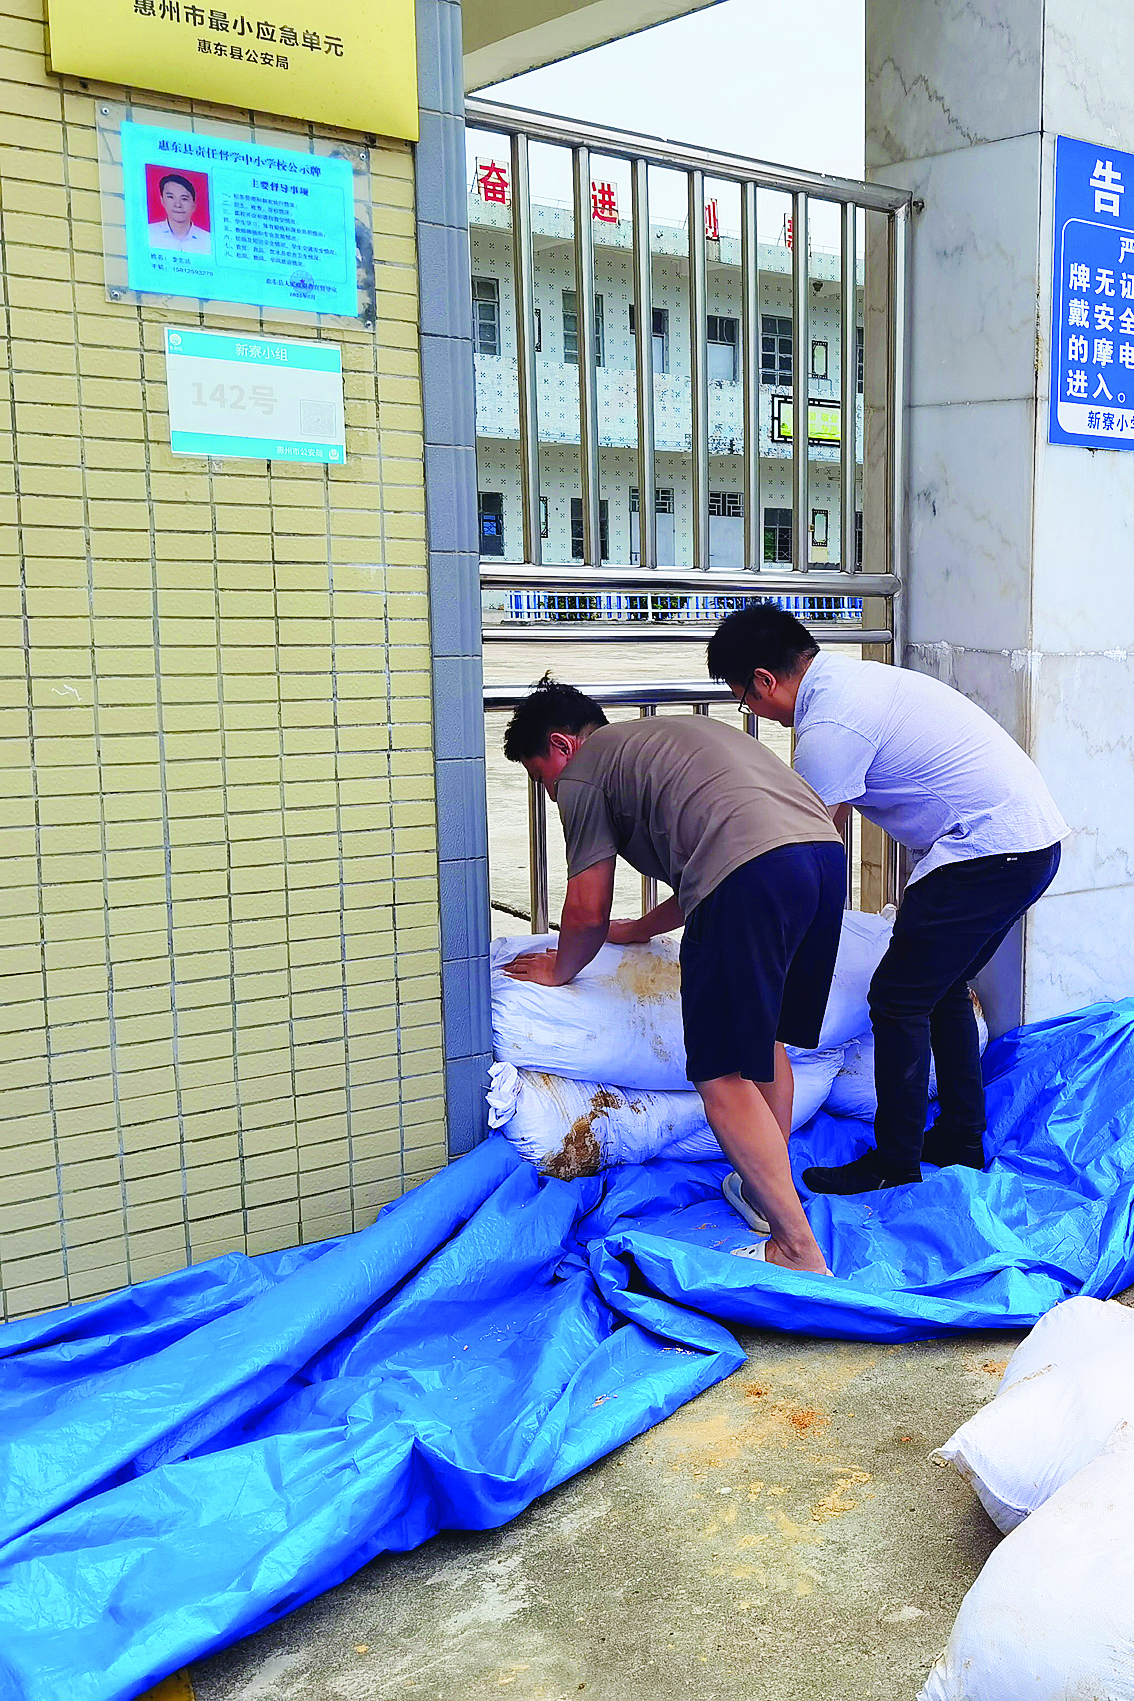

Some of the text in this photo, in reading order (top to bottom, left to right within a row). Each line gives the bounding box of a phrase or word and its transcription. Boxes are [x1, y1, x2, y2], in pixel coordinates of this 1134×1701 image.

[134, 0, 344, 57] 惠州市最小应急单元
[197, 38, 289, 70] 惠东县公安局
[235, 343, 288, 361] 新寮小组
[191, 381, 277, 416] 142号
[1066, 369, 1126, 403] 进入。
[276, 445, 324, 458] 惠州市公安局
